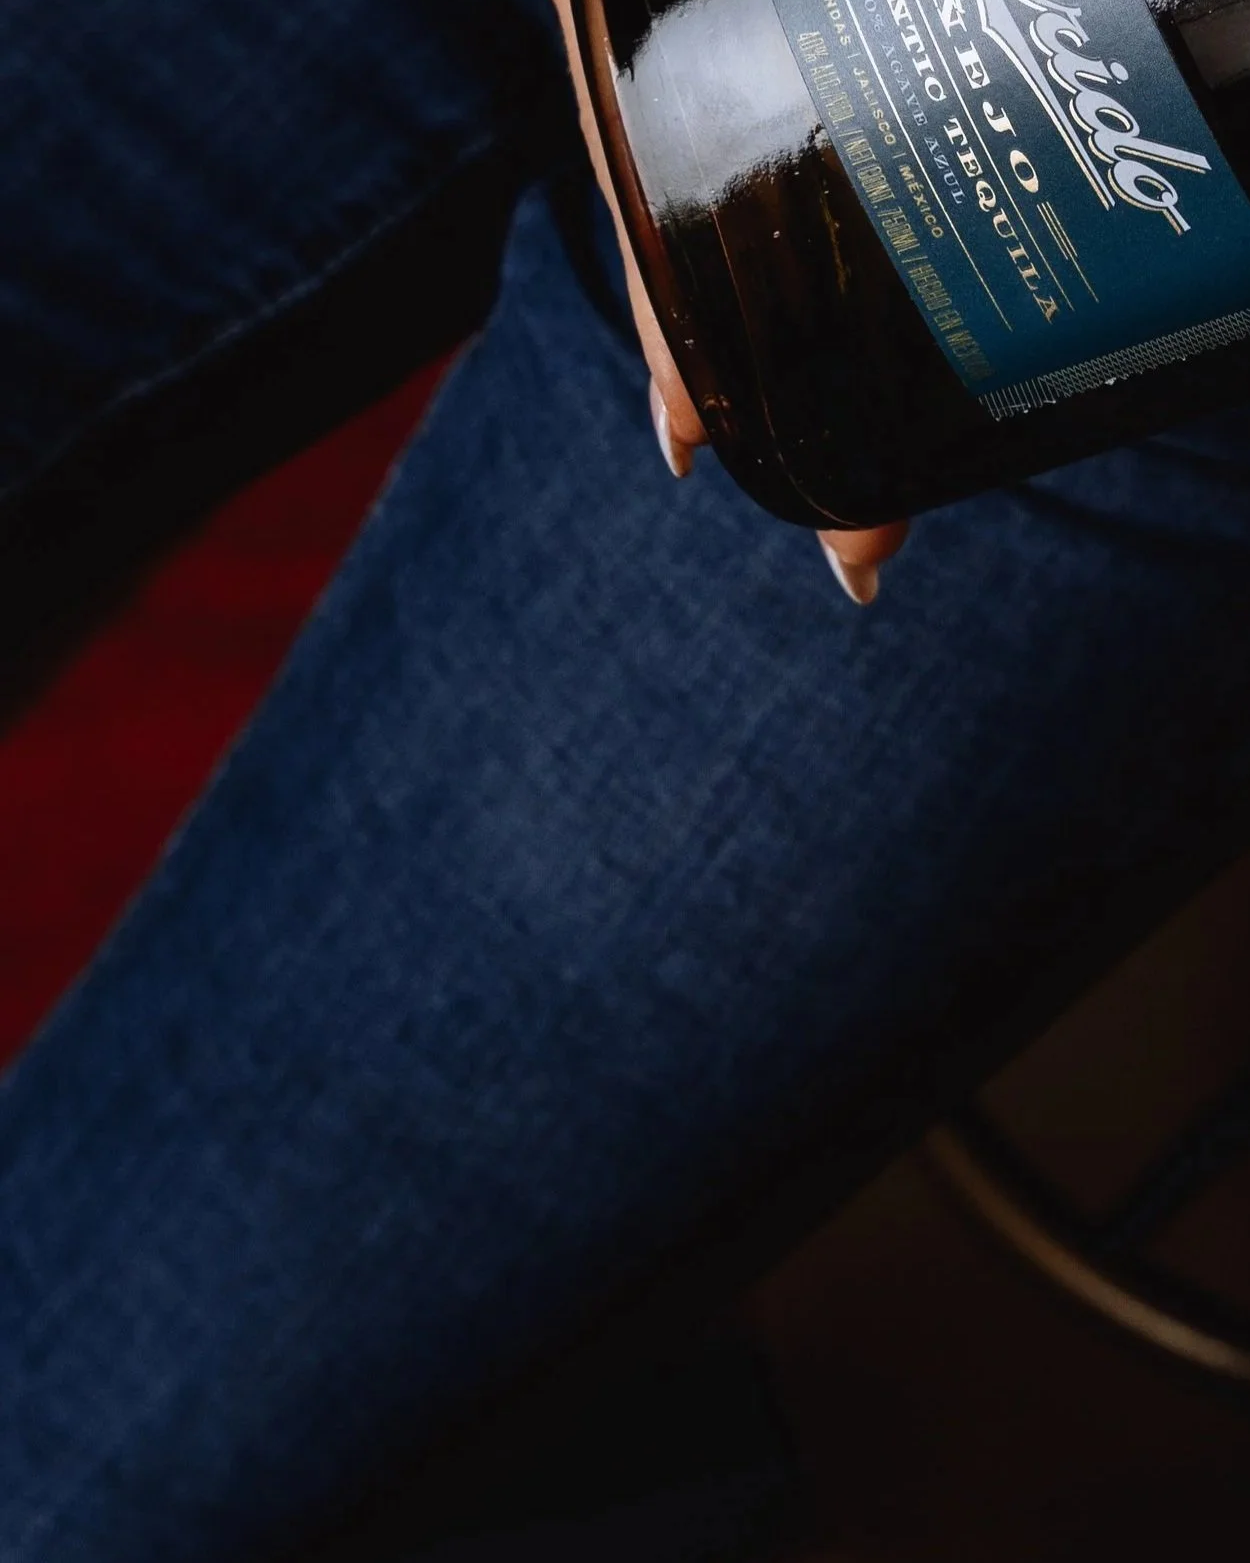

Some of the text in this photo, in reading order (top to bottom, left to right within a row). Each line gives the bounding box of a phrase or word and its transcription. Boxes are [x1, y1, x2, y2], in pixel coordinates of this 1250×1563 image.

[796, 30, 829, 64] 40%
[881, 42, 928, 126] AGAVE
[923, 137, 968, 205] AZUL
[844, 138, 877, 168] NET
[852, 66, 897, 146] JALISCO
[898, 164, 945, 239] MÉXICO
[856, 163, 897, 210] CONT.
[877, 205, 921, 256] 750ML
[943, 117, 1061, 325] TEQUILA
[907, 263, 954, 313] HECHO
[932, 308, 966, 333] EN
